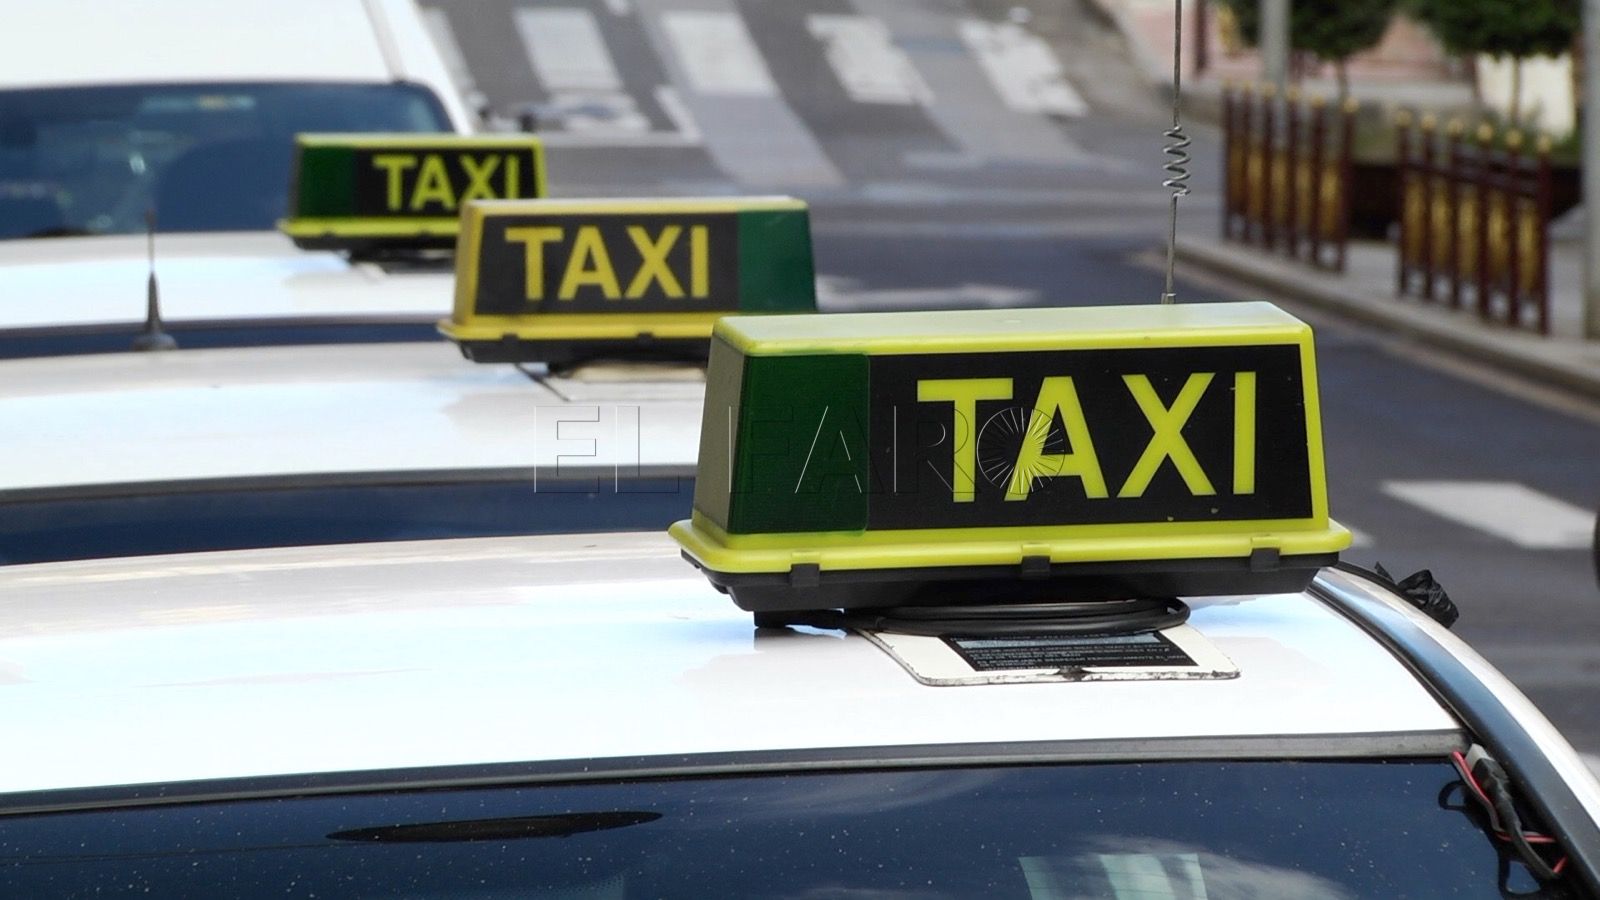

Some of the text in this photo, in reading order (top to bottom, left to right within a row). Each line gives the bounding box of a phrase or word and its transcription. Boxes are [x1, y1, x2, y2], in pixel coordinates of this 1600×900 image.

[373, 155, 520, 211] TAXI
[505, 225, 709, 300] TAXI
[917, 371, 1256, 502] TAXI
